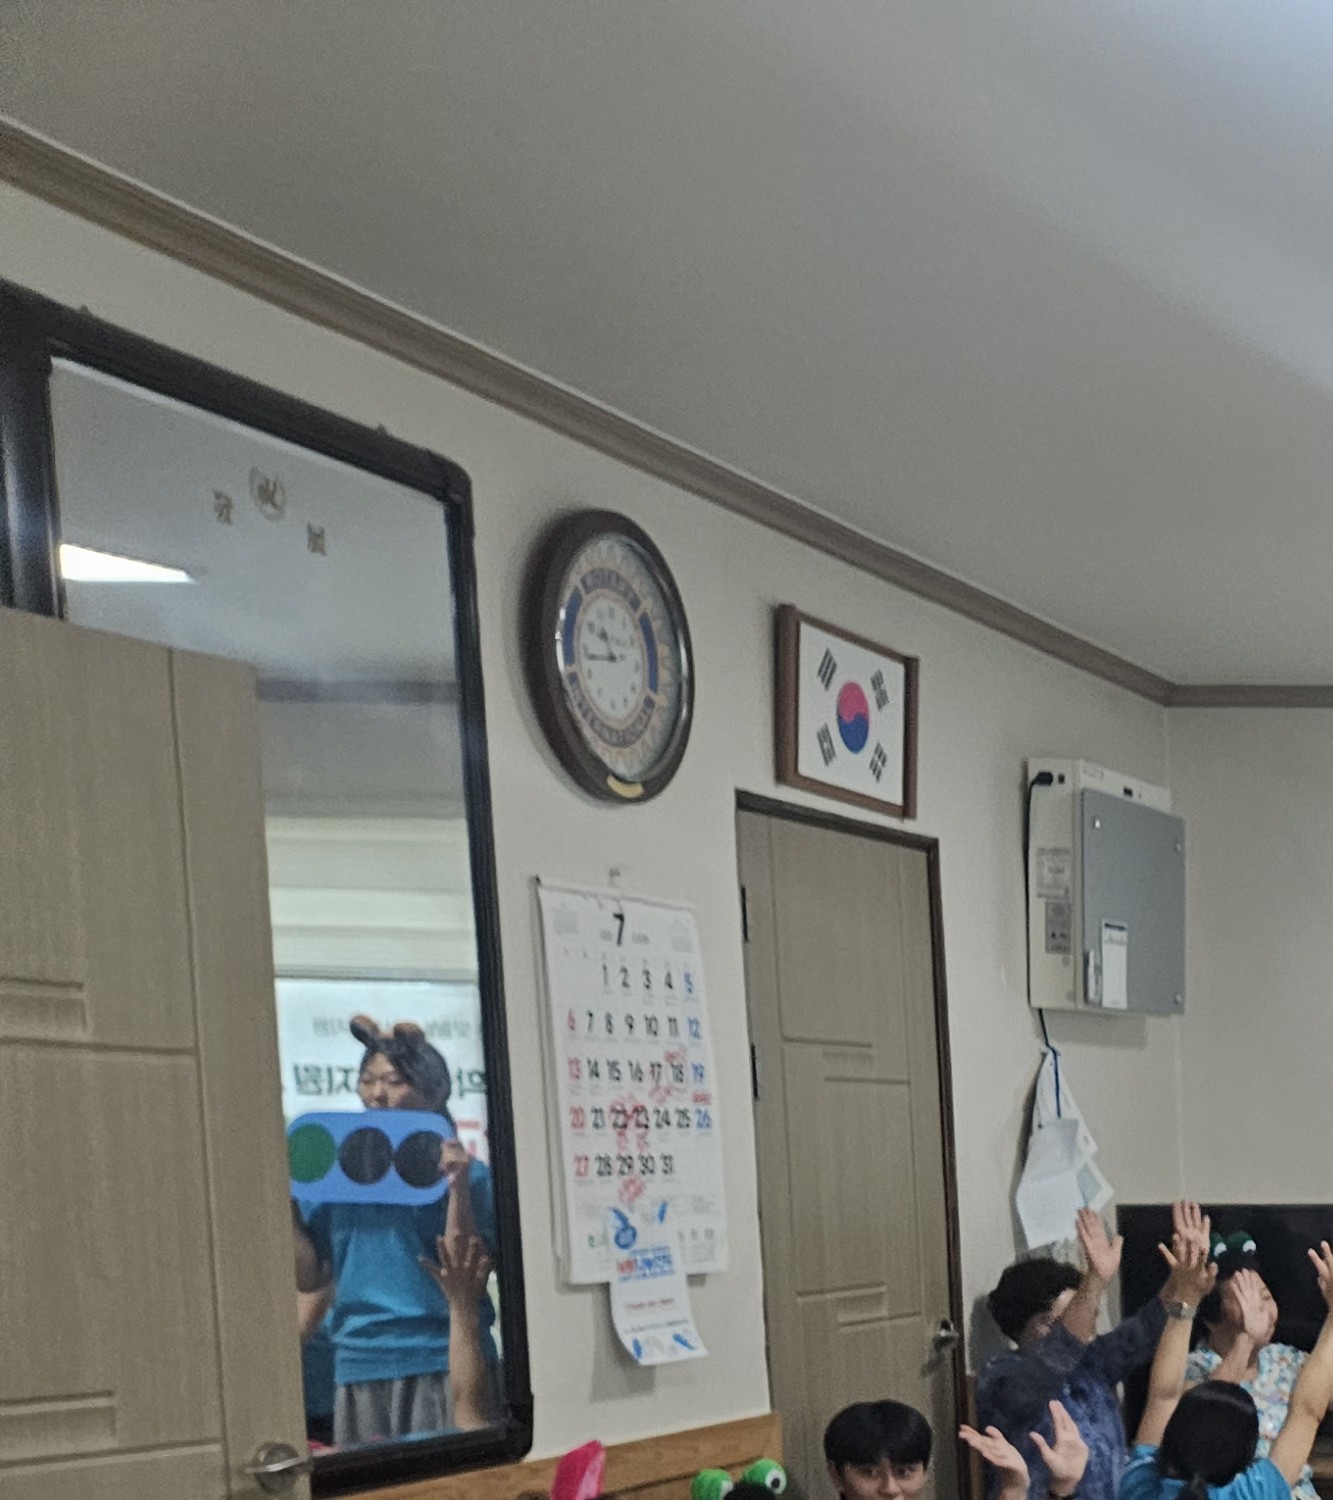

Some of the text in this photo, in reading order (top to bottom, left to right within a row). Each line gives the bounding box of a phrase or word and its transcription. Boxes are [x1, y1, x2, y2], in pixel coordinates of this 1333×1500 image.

[613, 912, 625, 946] 7
[602, 964, 610, 986] 1
[620, 966, 630, 988] 2
[643, 968, 652, 990] 3
[664, 971, 673, 990] 4
[586, 1010, 594, 1033] 7
[604, 1011, 613, 1034] 8
[625, 1013, 634, 1035] 9
[643, 1014, 659, 1037] 10
[667, 1016, 679, 1038] 11
[687, 1017, 702, 1040] 12
[568, 1056, 705, 1084] 13 14 15 16 17 18 19
[569, 1106, 585, 1129] 20
[591, 1106, 605, 1130] 21
[610, 1107, 628, 1130] 22
[653, 1106, 671, 1129] 24
[675, 1107, 691, 1129] 25
[695, 1107, 713, 1130] 26
[574, 1152, 674, 1177] 27 28 29 30 31
